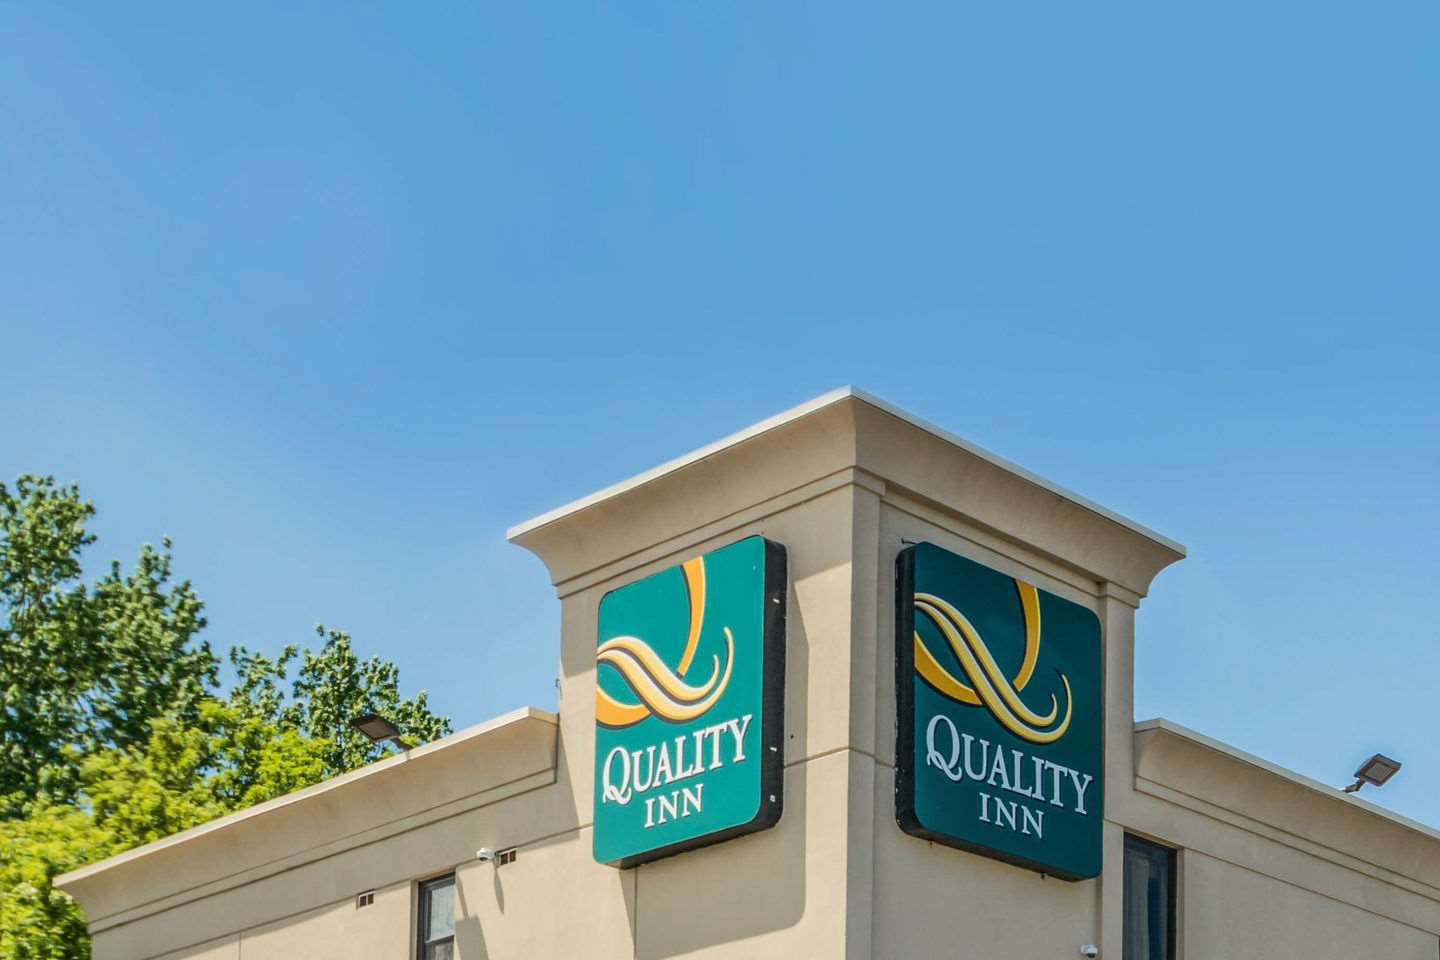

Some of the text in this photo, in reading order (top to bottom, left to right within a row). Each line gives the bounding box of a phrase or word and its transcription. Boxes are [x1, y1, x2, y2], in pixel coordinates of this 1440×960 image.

[603, 714, 752, 805] QUALITY
[926, 714, 1093, 815] QUALITY
[644, 784, 704, 828] INN
[979, 792, 1044, 840] INN
